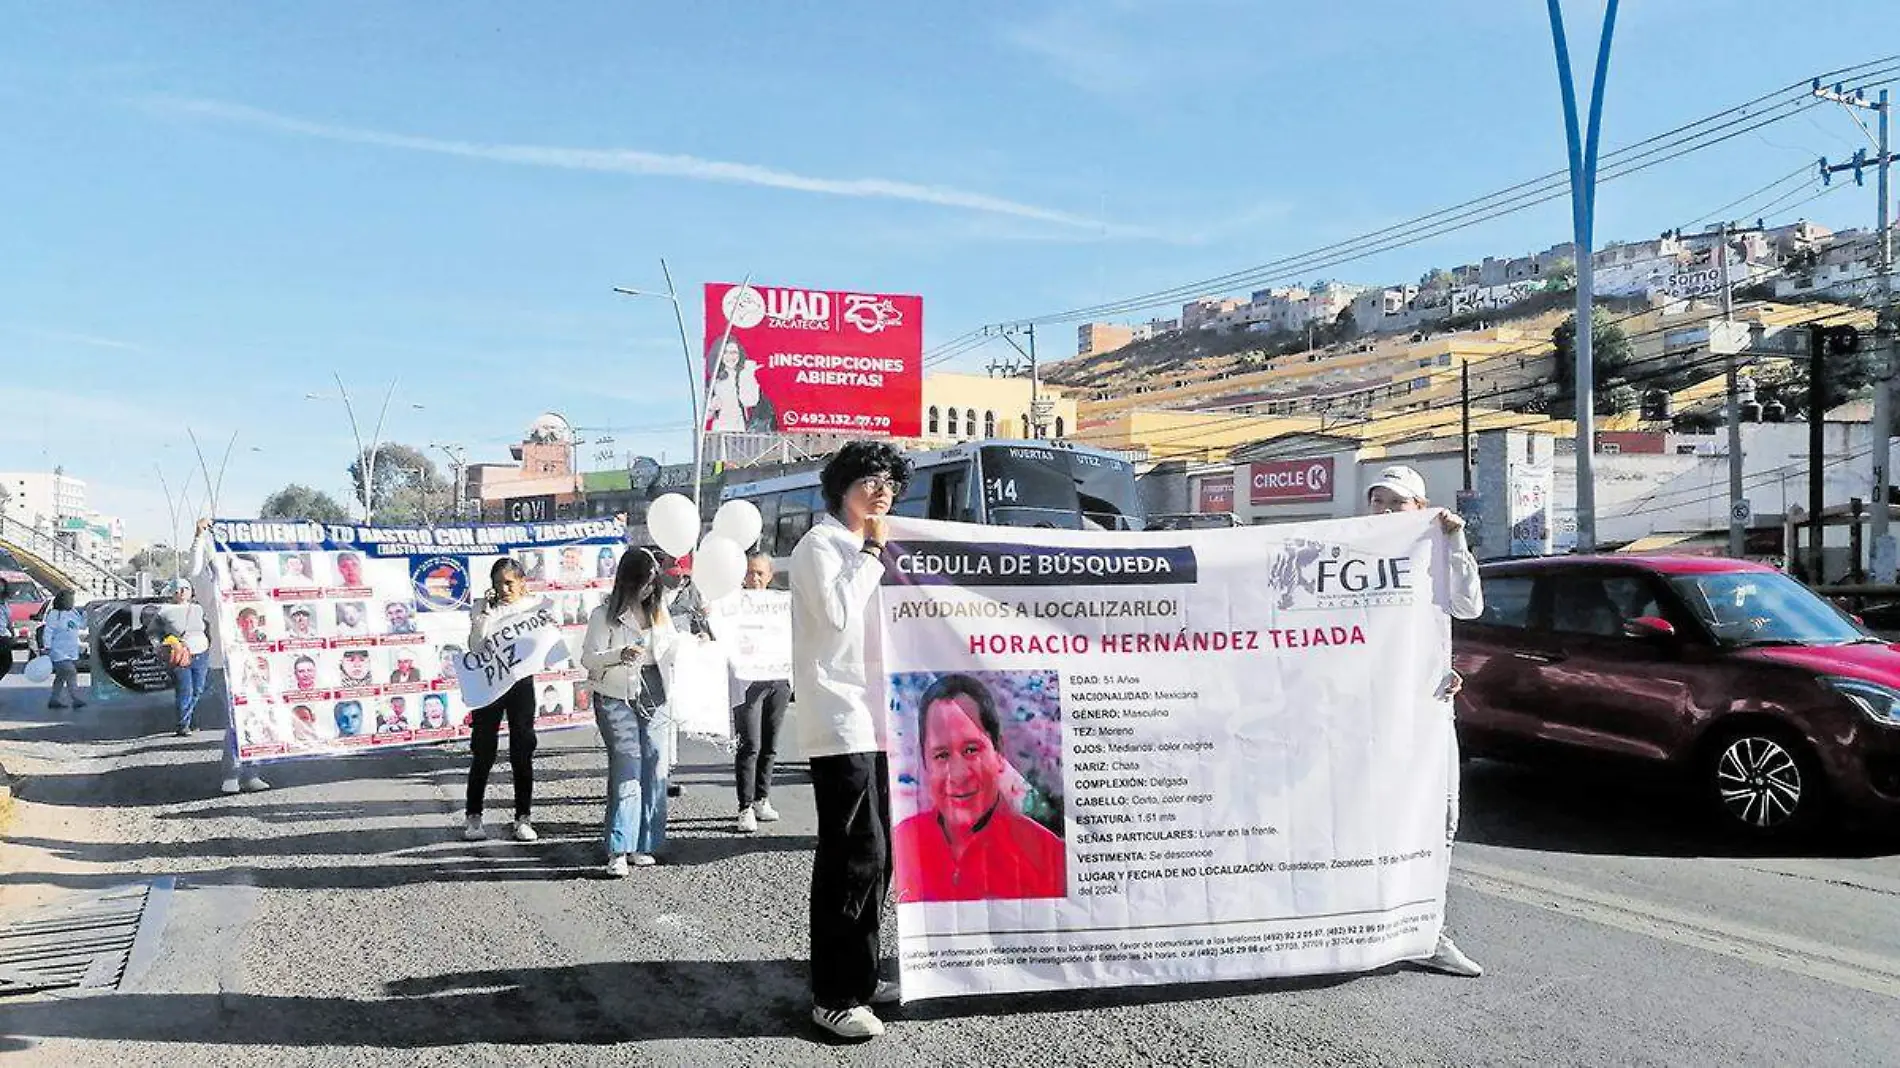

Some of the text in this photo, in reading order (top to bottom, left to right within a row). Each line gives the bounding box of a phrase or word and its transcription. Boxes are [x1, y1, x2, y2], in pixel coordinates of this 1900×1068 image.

[767, 289, 830, 320] UAD
[769, 319, 830, 330] ZACATECAS
[769, 353, 904, 372] ¡INSCRIPCIONES
[796, 371, 883, 387] ABIERTAS!
[1253, 471, 1304, 488] CIRCLE
[994, 478, 1018, 501] 14
[512, 500, 546, 521] GOVI
[214, 521, 325, 544] SIGUIENDO
[359, 527, 432, 545] RASTRO
[435, 528, 474, 545] CON
[534, 518, 625, 541] ZACATECAS
[895, 551, 1172, 576] CÉDULA DE BÚSQUEDA
[1316, 556, 1412, 593] FGJE
[892, 598, 1178, 623] ¡AYÚDANOS A LOCALIZARLO!
[968, 625, 1366, 654] HORACIO HERNÁNDEZ TEJADA
[484, 643, 522, 687] PAZ
[1070, 674, 1140, 685] EDAD: 51 Años
[1071, 690, 1199, 701] NACIONALIDAD: Mexicana
[1072, 708, 1169, 719] GÉNERO: Masculino
[1073, 727, 1134, 737] TEZ: Moreno
[1073, 744, 1106, 754] OJOS:
[1158, 742, 1181, 751] color
[1183, 741, 1214, 752] negros
[1074, 761, 1140, 772] NARIZ: Chata
[1075, 777, 1188, 790] COMPLEXIÓN: Delgada
[1075, 796, 1130, 807] CABELLO:
[1162, 794, 1185, 803] color
[1187, 794, 1214, 803] negro
[1076, 815, 1134, 825] ESTATURA:
[1077, 831, 1113, 844] SEÑAS
[1116, 829, 1197, 842] PARTICULARES:
[1199, 829, 1225, 838] Lunar
[1227, 830, 1240, 838] en
[1241, 828, 1250, 836] la
[1077, 849, 1213, 863] VESTIMENTA: Se desconoce
[1078, 871, 1116, 882] LUGAR
[1117, 871, 1124, 880] Y
[1127, 869, 1162, 881] FECHA
[1165, 869, 1179, 878] DE
[1181, 868, 1196, 878] NO
[1078, 886, 1093, 896] del
[989, 945, 1037, 955] relacionada
[1120, 942, 1140, 950] favor
[1143, 941, 1153, 949] de
[1214, 936, 1225, 944] los
[1016, 956, 1027, 965] de
[1085, 954, 1096, 963] del
[1129, 952, 1140, 960] las
